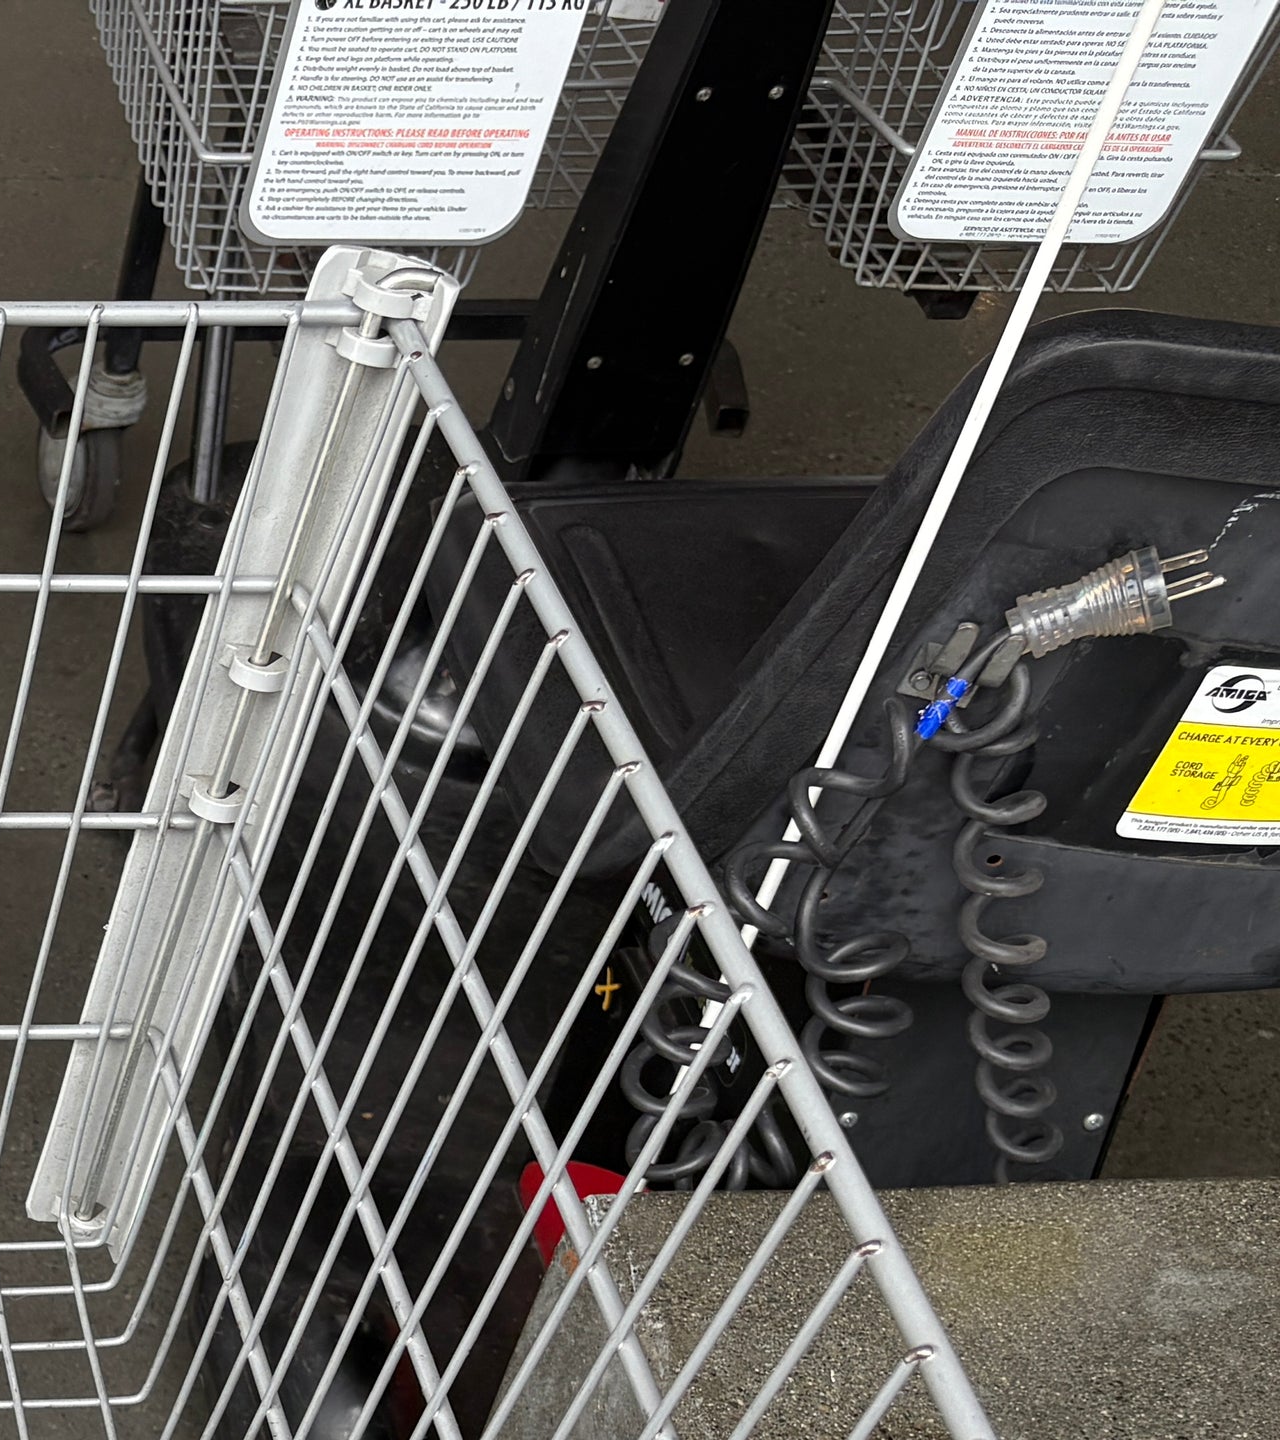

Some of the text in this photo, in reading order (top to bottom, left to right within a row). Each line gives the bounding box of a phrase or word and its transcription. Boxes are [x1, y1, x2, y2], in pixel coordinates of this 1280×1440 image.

[284, 128, 530, 138] OPERATING INSTRUCTIONS: PLEASE READ BEFORE OPERATING
[956, 129, 987, 137] MANUAL
[1178, 732, 1279, 746] CHARGE AT EVERY
[1175, 761, 1203, 770] CORD
[1170, 768, 1218, 780] STORAGE
